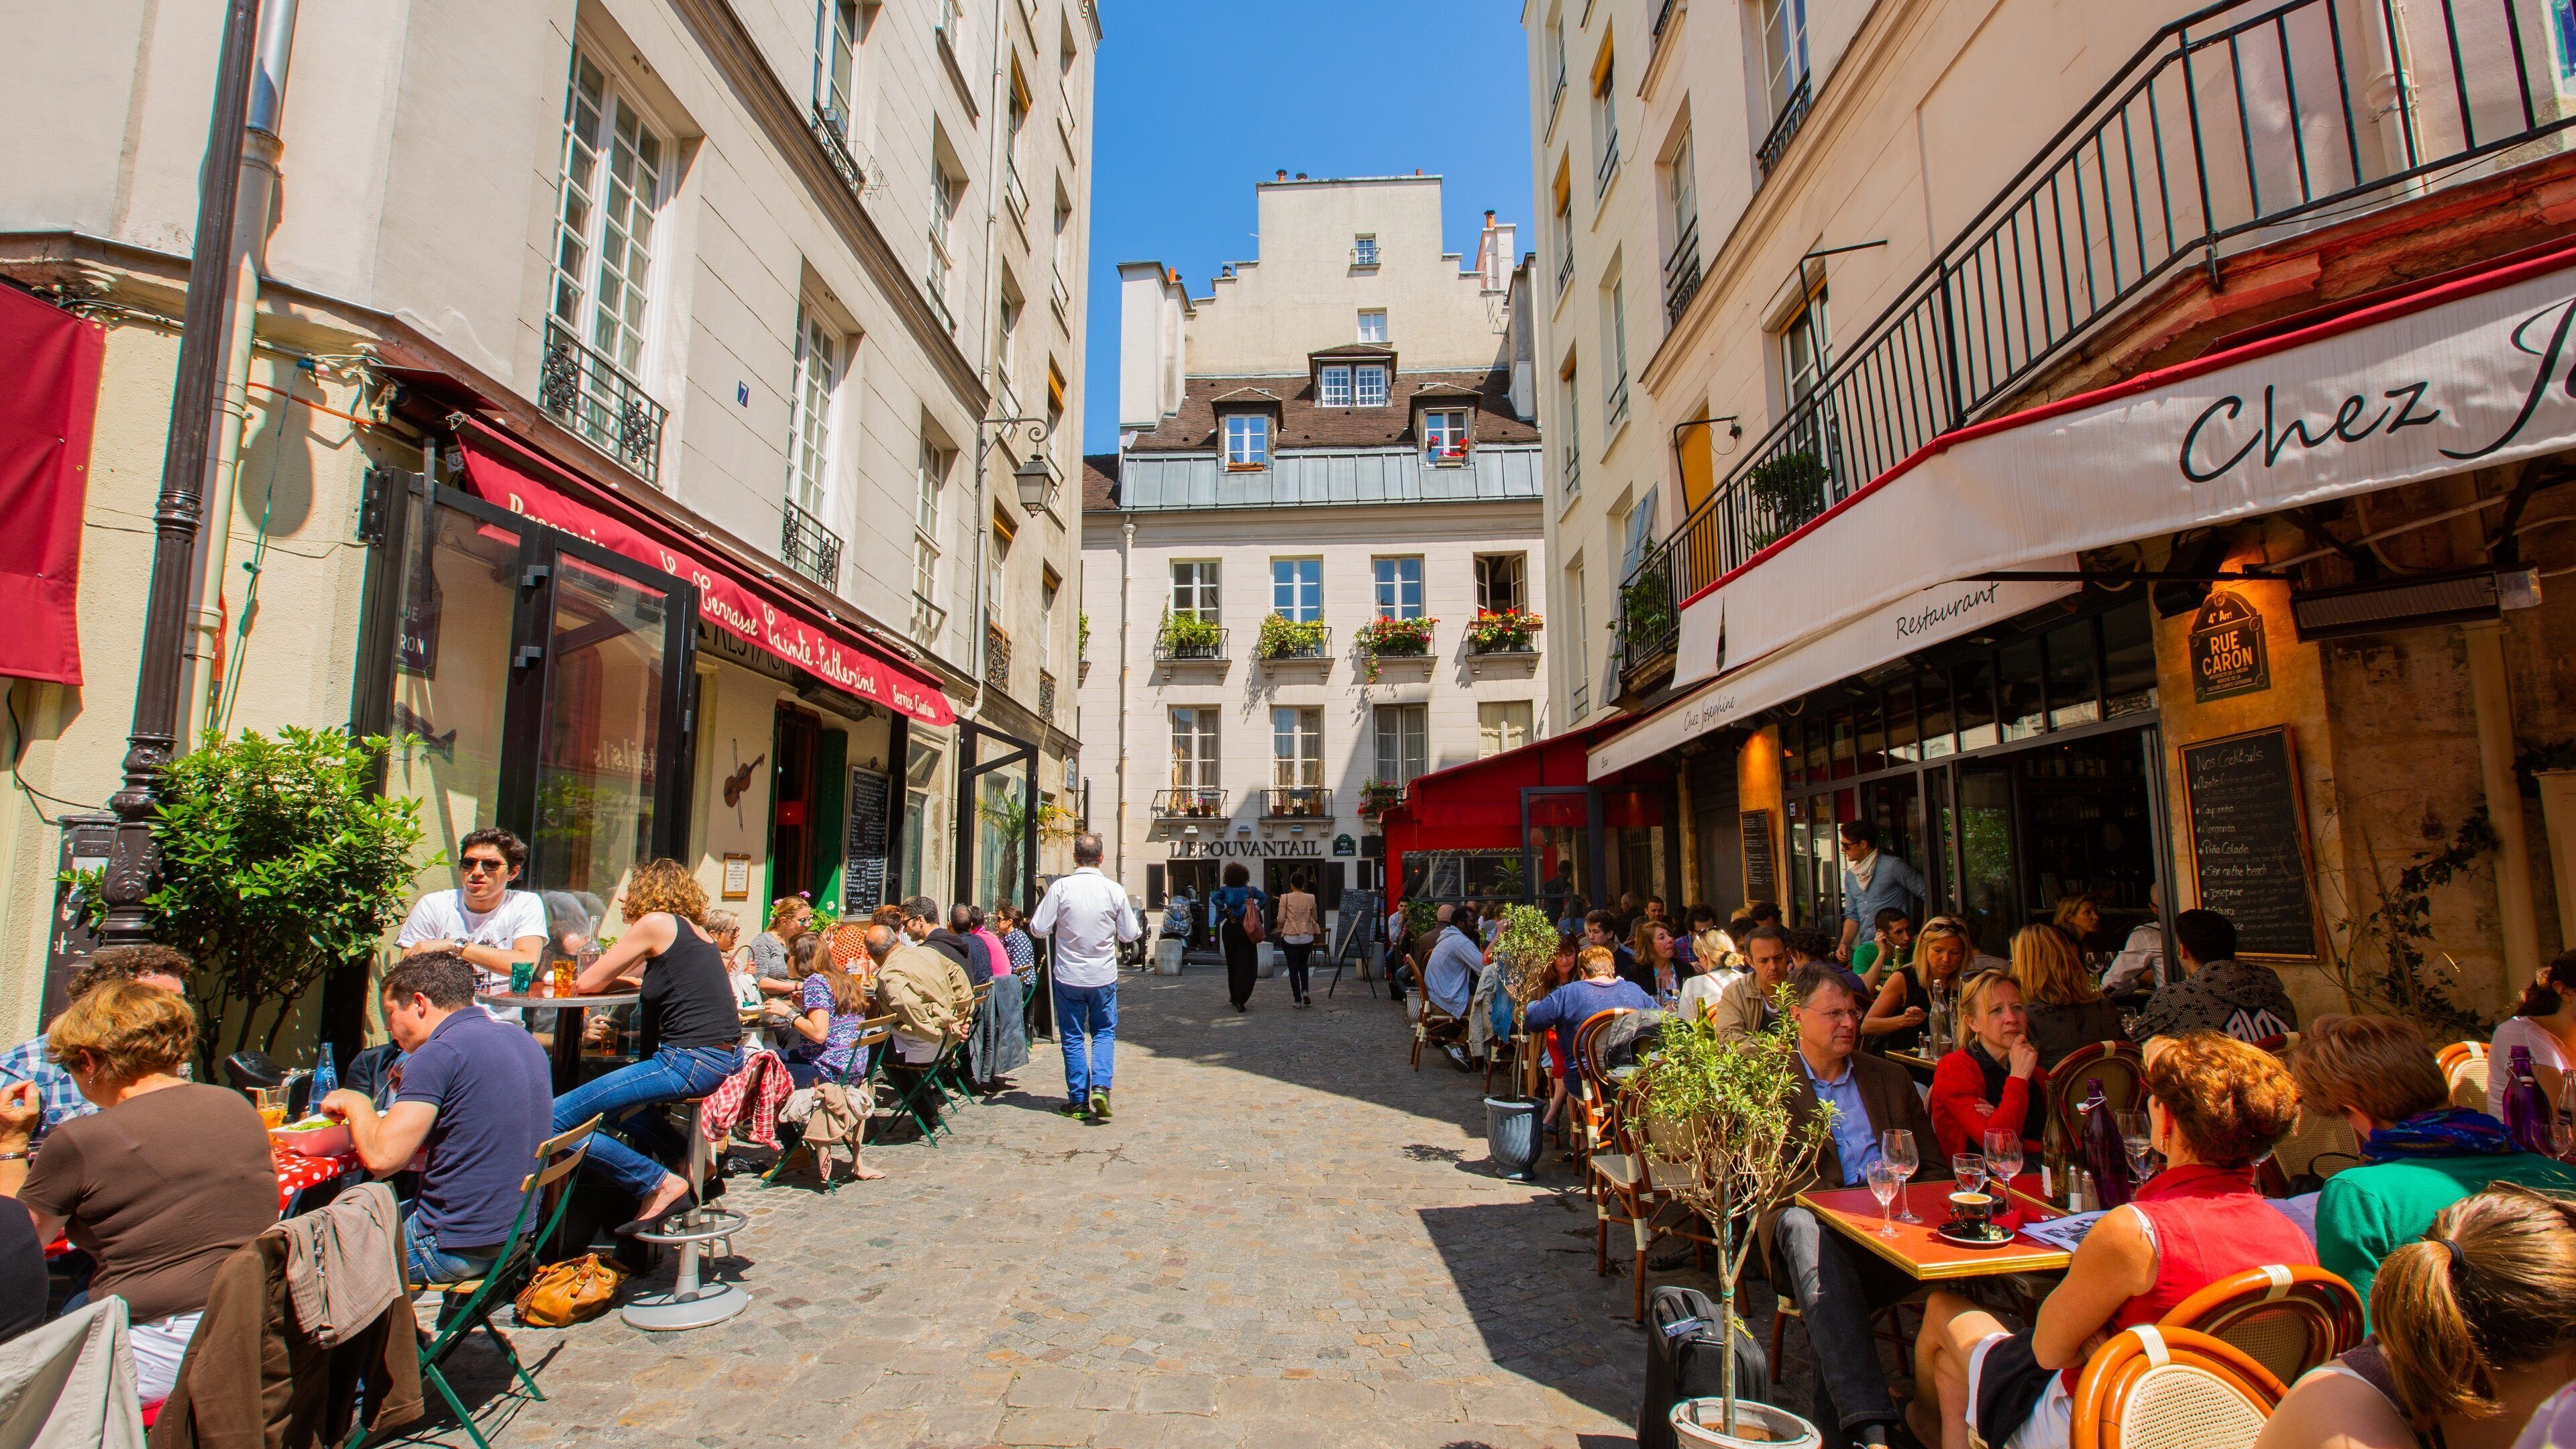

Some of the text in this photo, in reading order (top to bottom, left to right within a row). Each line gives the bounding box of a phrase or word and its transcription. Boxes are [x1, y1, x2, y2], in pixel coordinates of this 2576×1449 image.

[740, 383, 748, 405] 7
[2179, 298, 2576, 483] Chez J
[693, 571, 758, 636] Terrasse
[1896, 582, 2000, 639] Restaurant
[2210, 631, 2240, 655] RUE
[2202, 647, 2253, 676] CARON
[892, 684, 913, 710] Service
[1684, 708, 1699, 731] Chez
[1597, 756, 1609, 769] Bar
[2196, 752, 2216, 771] Nos
[1169, 839, 1322, 858] L'EPOUVANTAIL
[2221, 841, 2250, 855] Colada
[2206, 865, 2220, 876] Sex
[2230, 864, 2243, 876] the
[2246, 863, 2268, 876] beach
